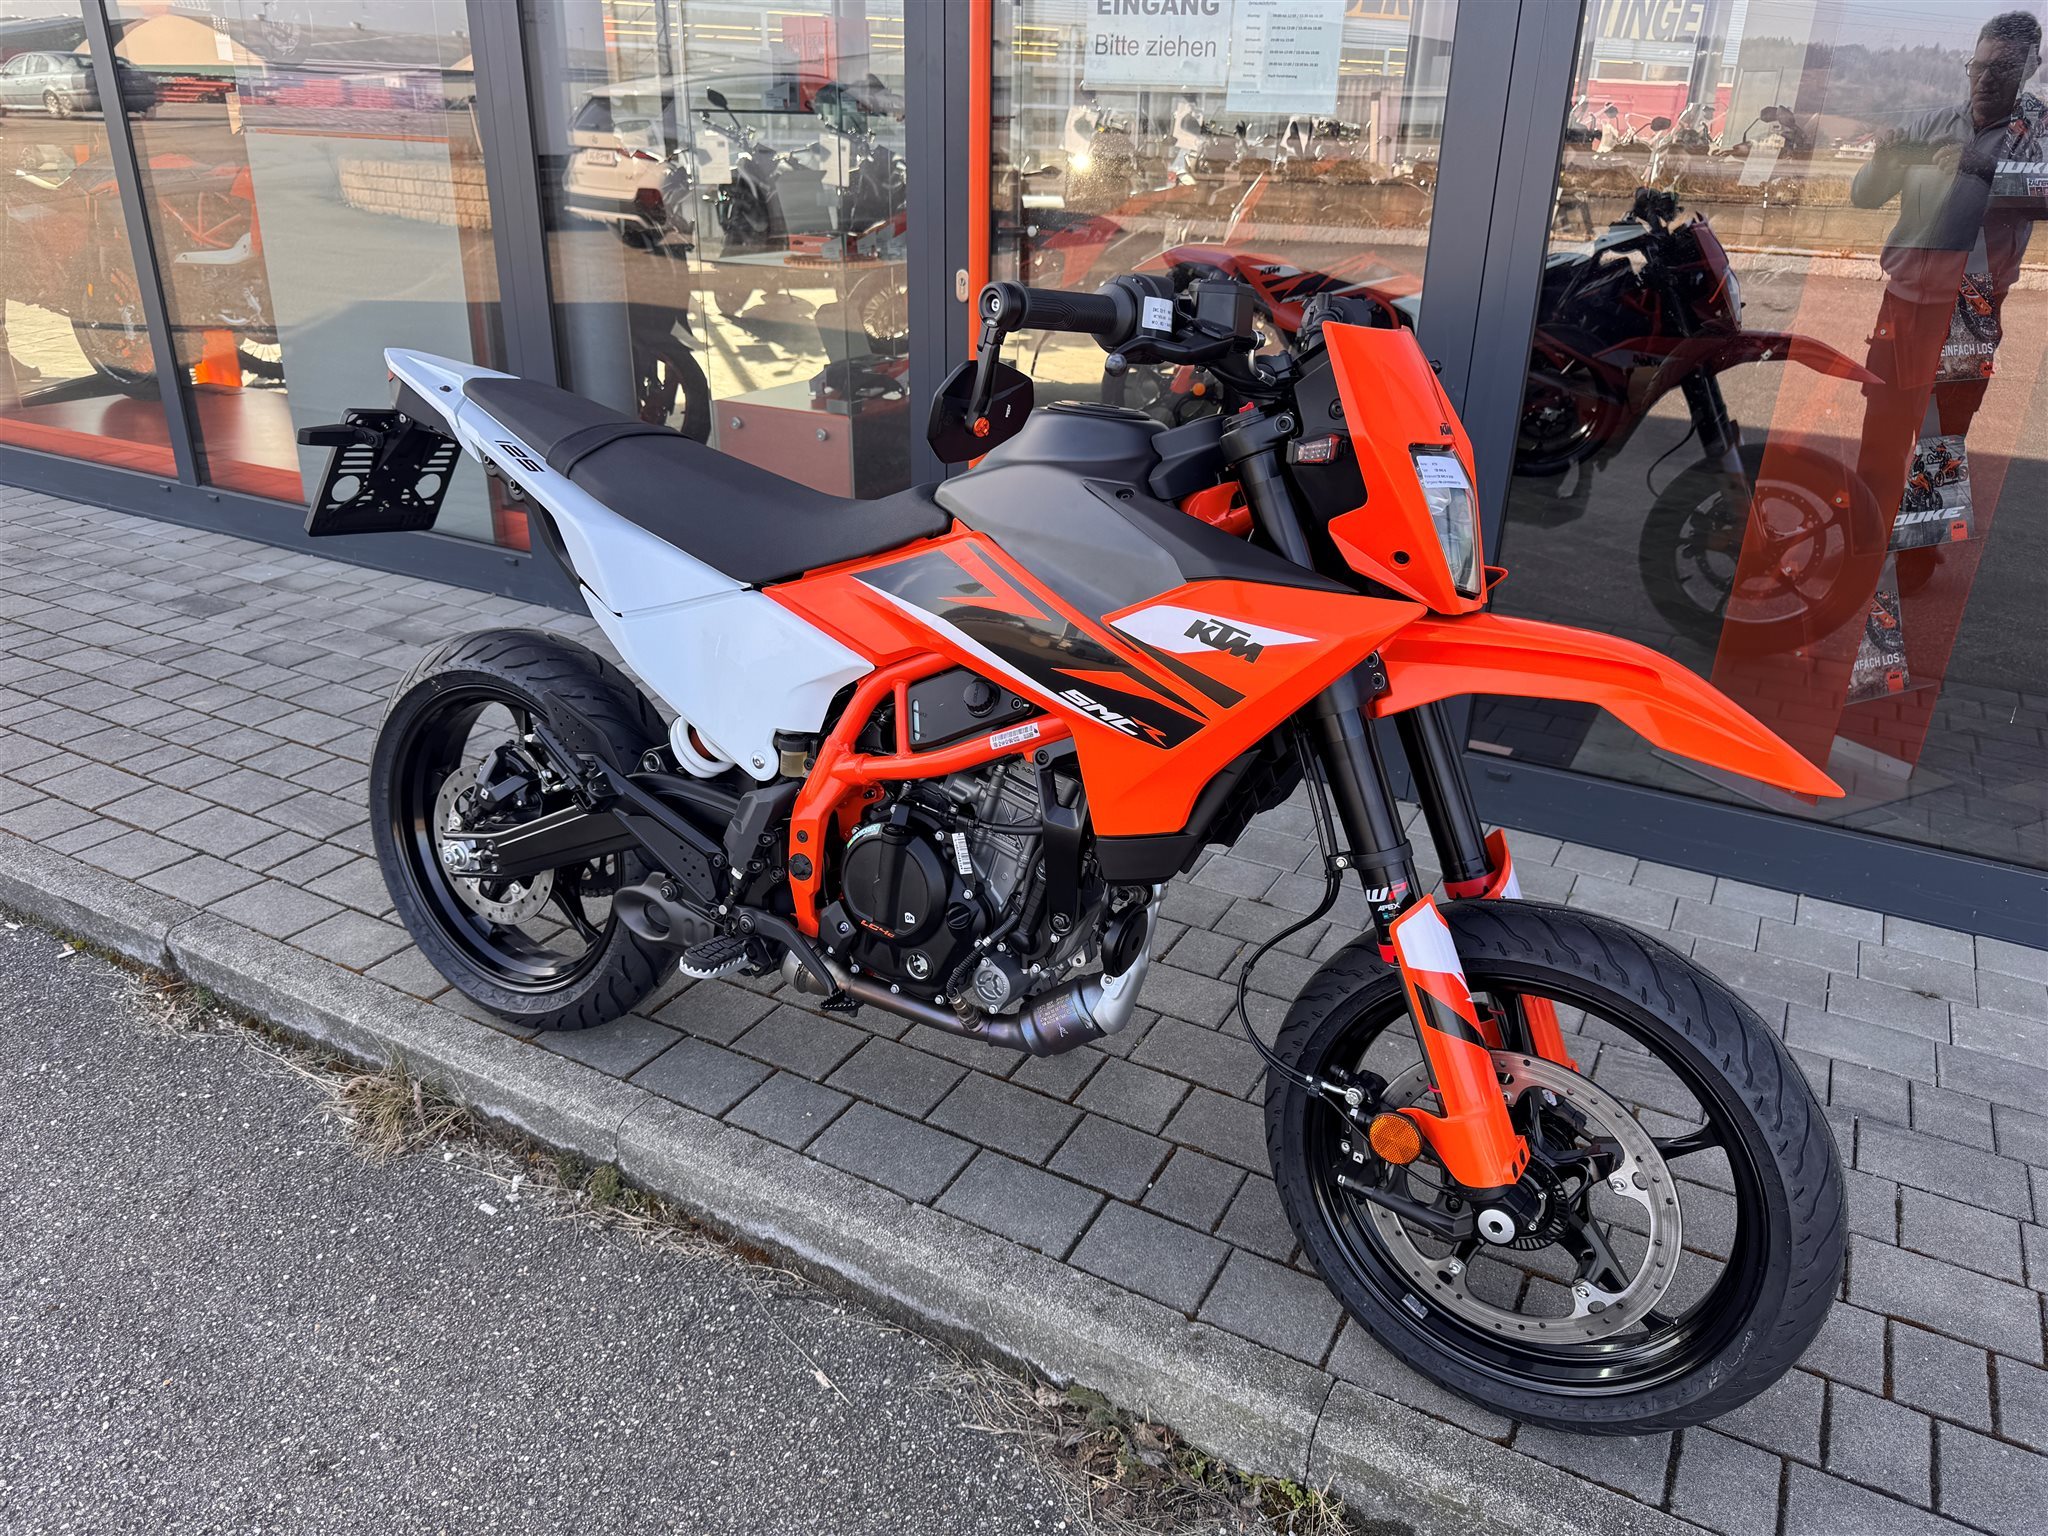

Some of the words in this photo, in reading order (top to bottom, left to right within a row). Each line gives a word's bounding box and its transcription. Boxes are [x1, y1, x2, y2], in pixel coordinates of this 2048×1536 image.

[1097, 0, 1220, 16] EINGANG
[1095, 34, 1140, 56] Bitte
[1146, 34, 1217, 57] ziehen
[1977, 342, 1994, 354] LOS
[494, 440, 546, 473] 125
[1183, 618, 1265, 664] KTM
[1882, 652, 1900, 666] LOS
[1366, 881, 1408, 903] WP
[1377, 902, 1401, 912] APEX
